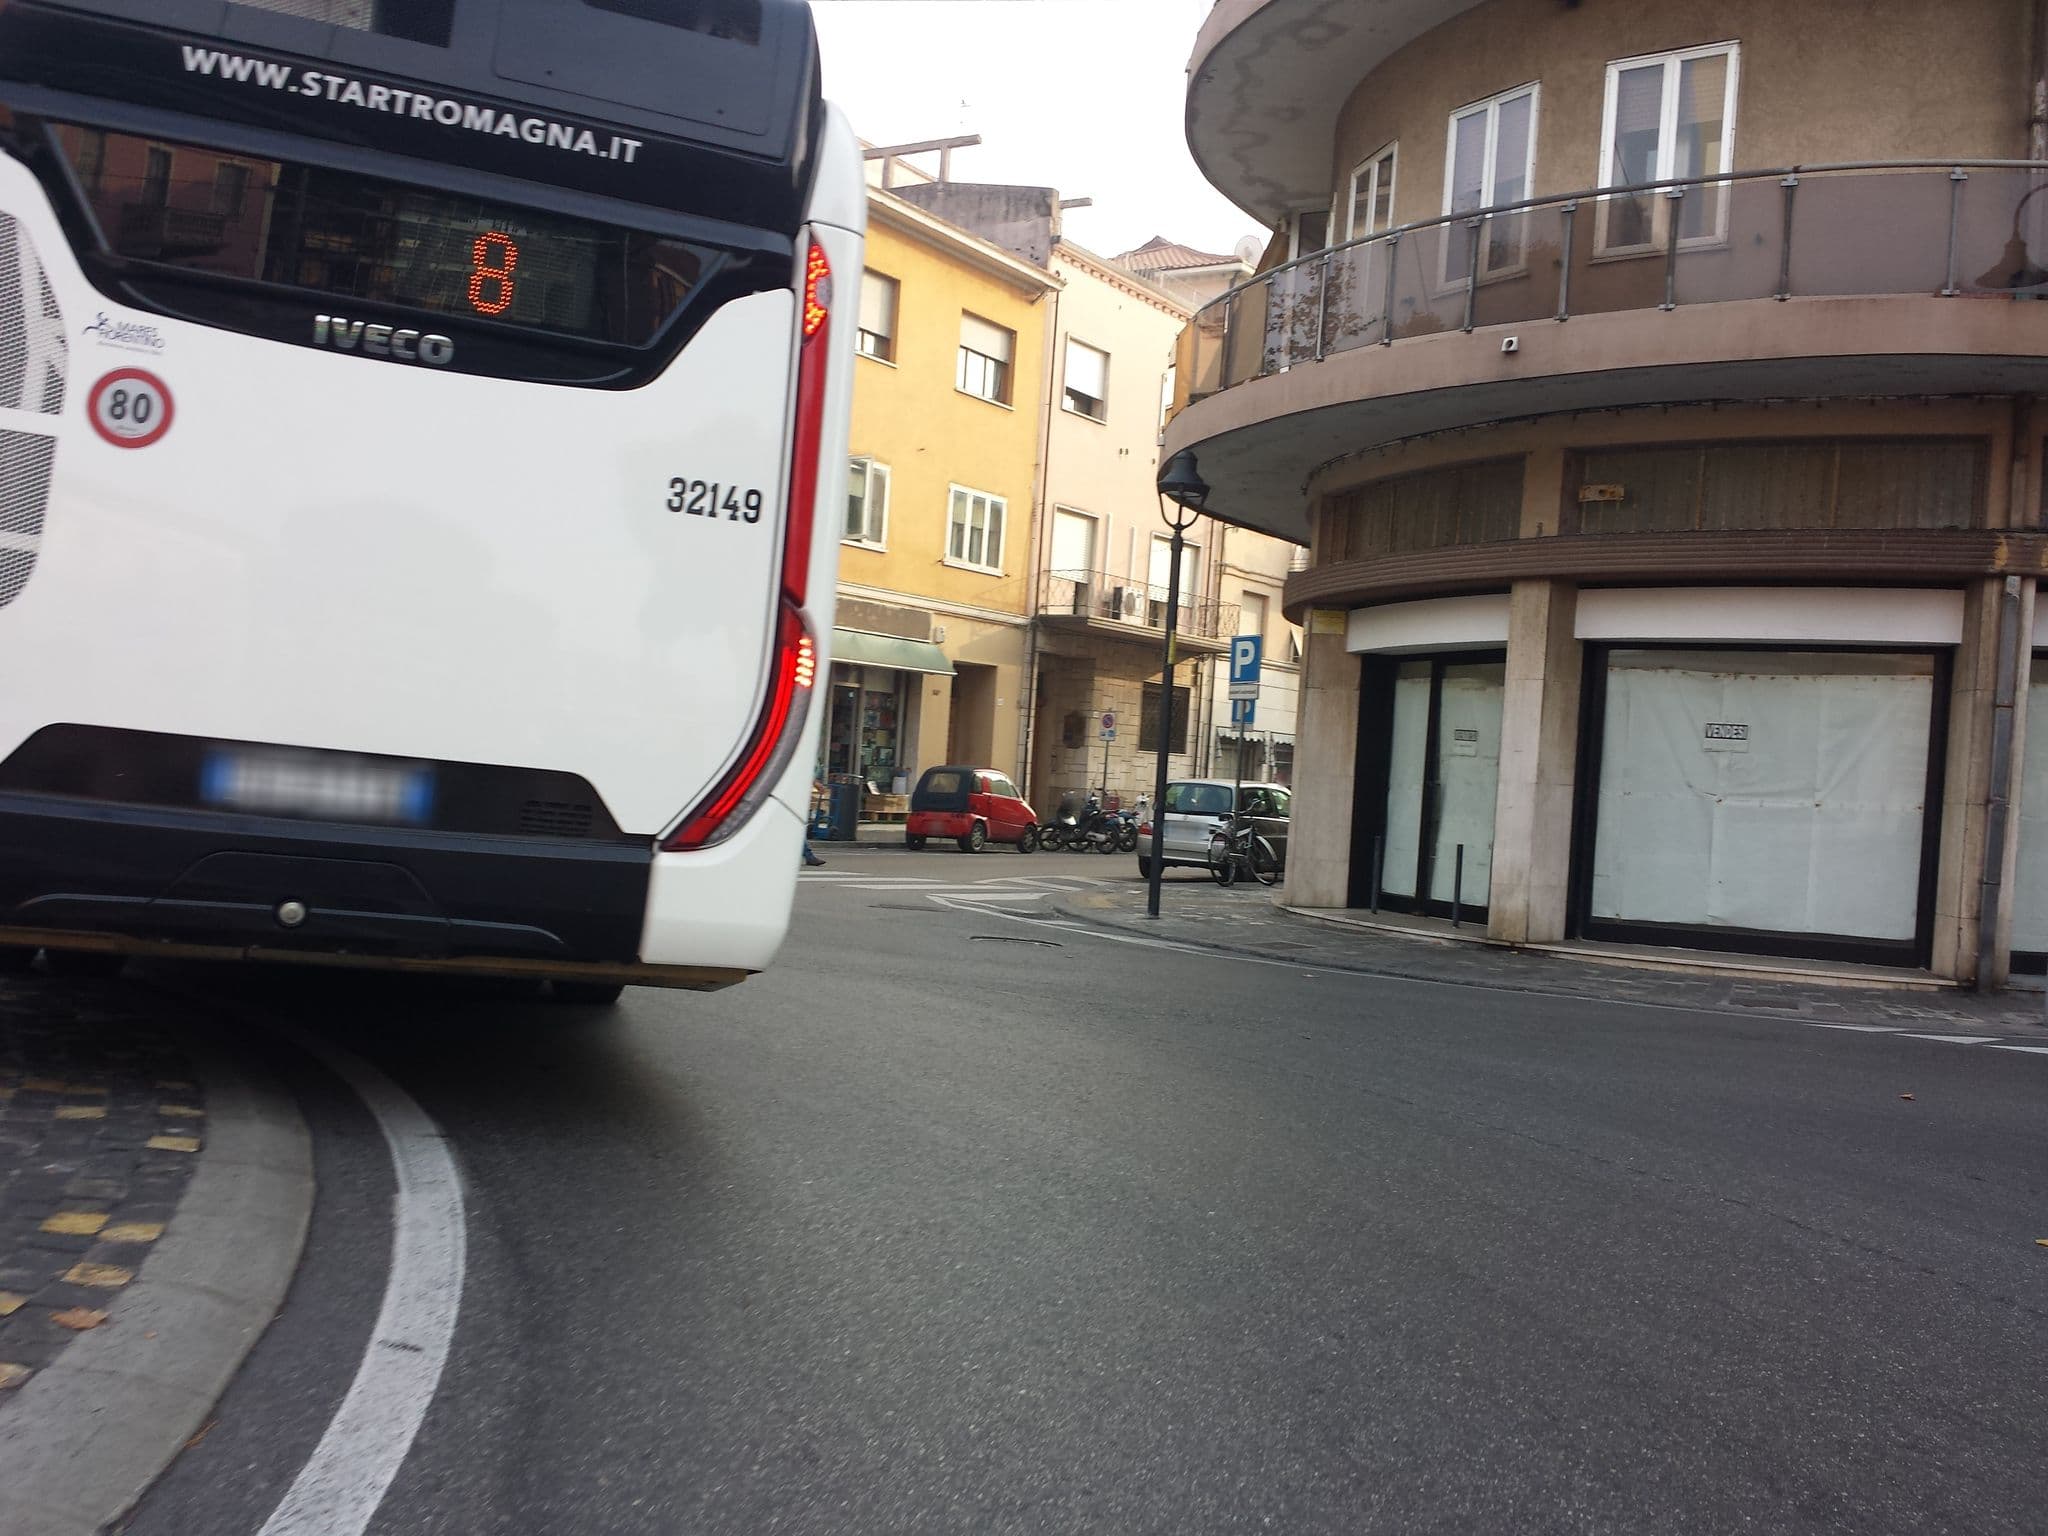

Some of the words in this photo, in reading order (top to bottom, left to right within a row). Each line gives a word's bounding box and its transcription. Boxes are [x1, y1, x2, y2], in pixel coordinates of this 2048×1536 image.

[181, 45, 643, 165] WWW.STARTROMAGNA.IT
[467, 230, 520, 315] 8
[313, 313, 455, 366] IVECO
[110, 388, 152, 425] 80
[666, 476, 763, 525] 32149
[1234, 640, 1255, 678] P
